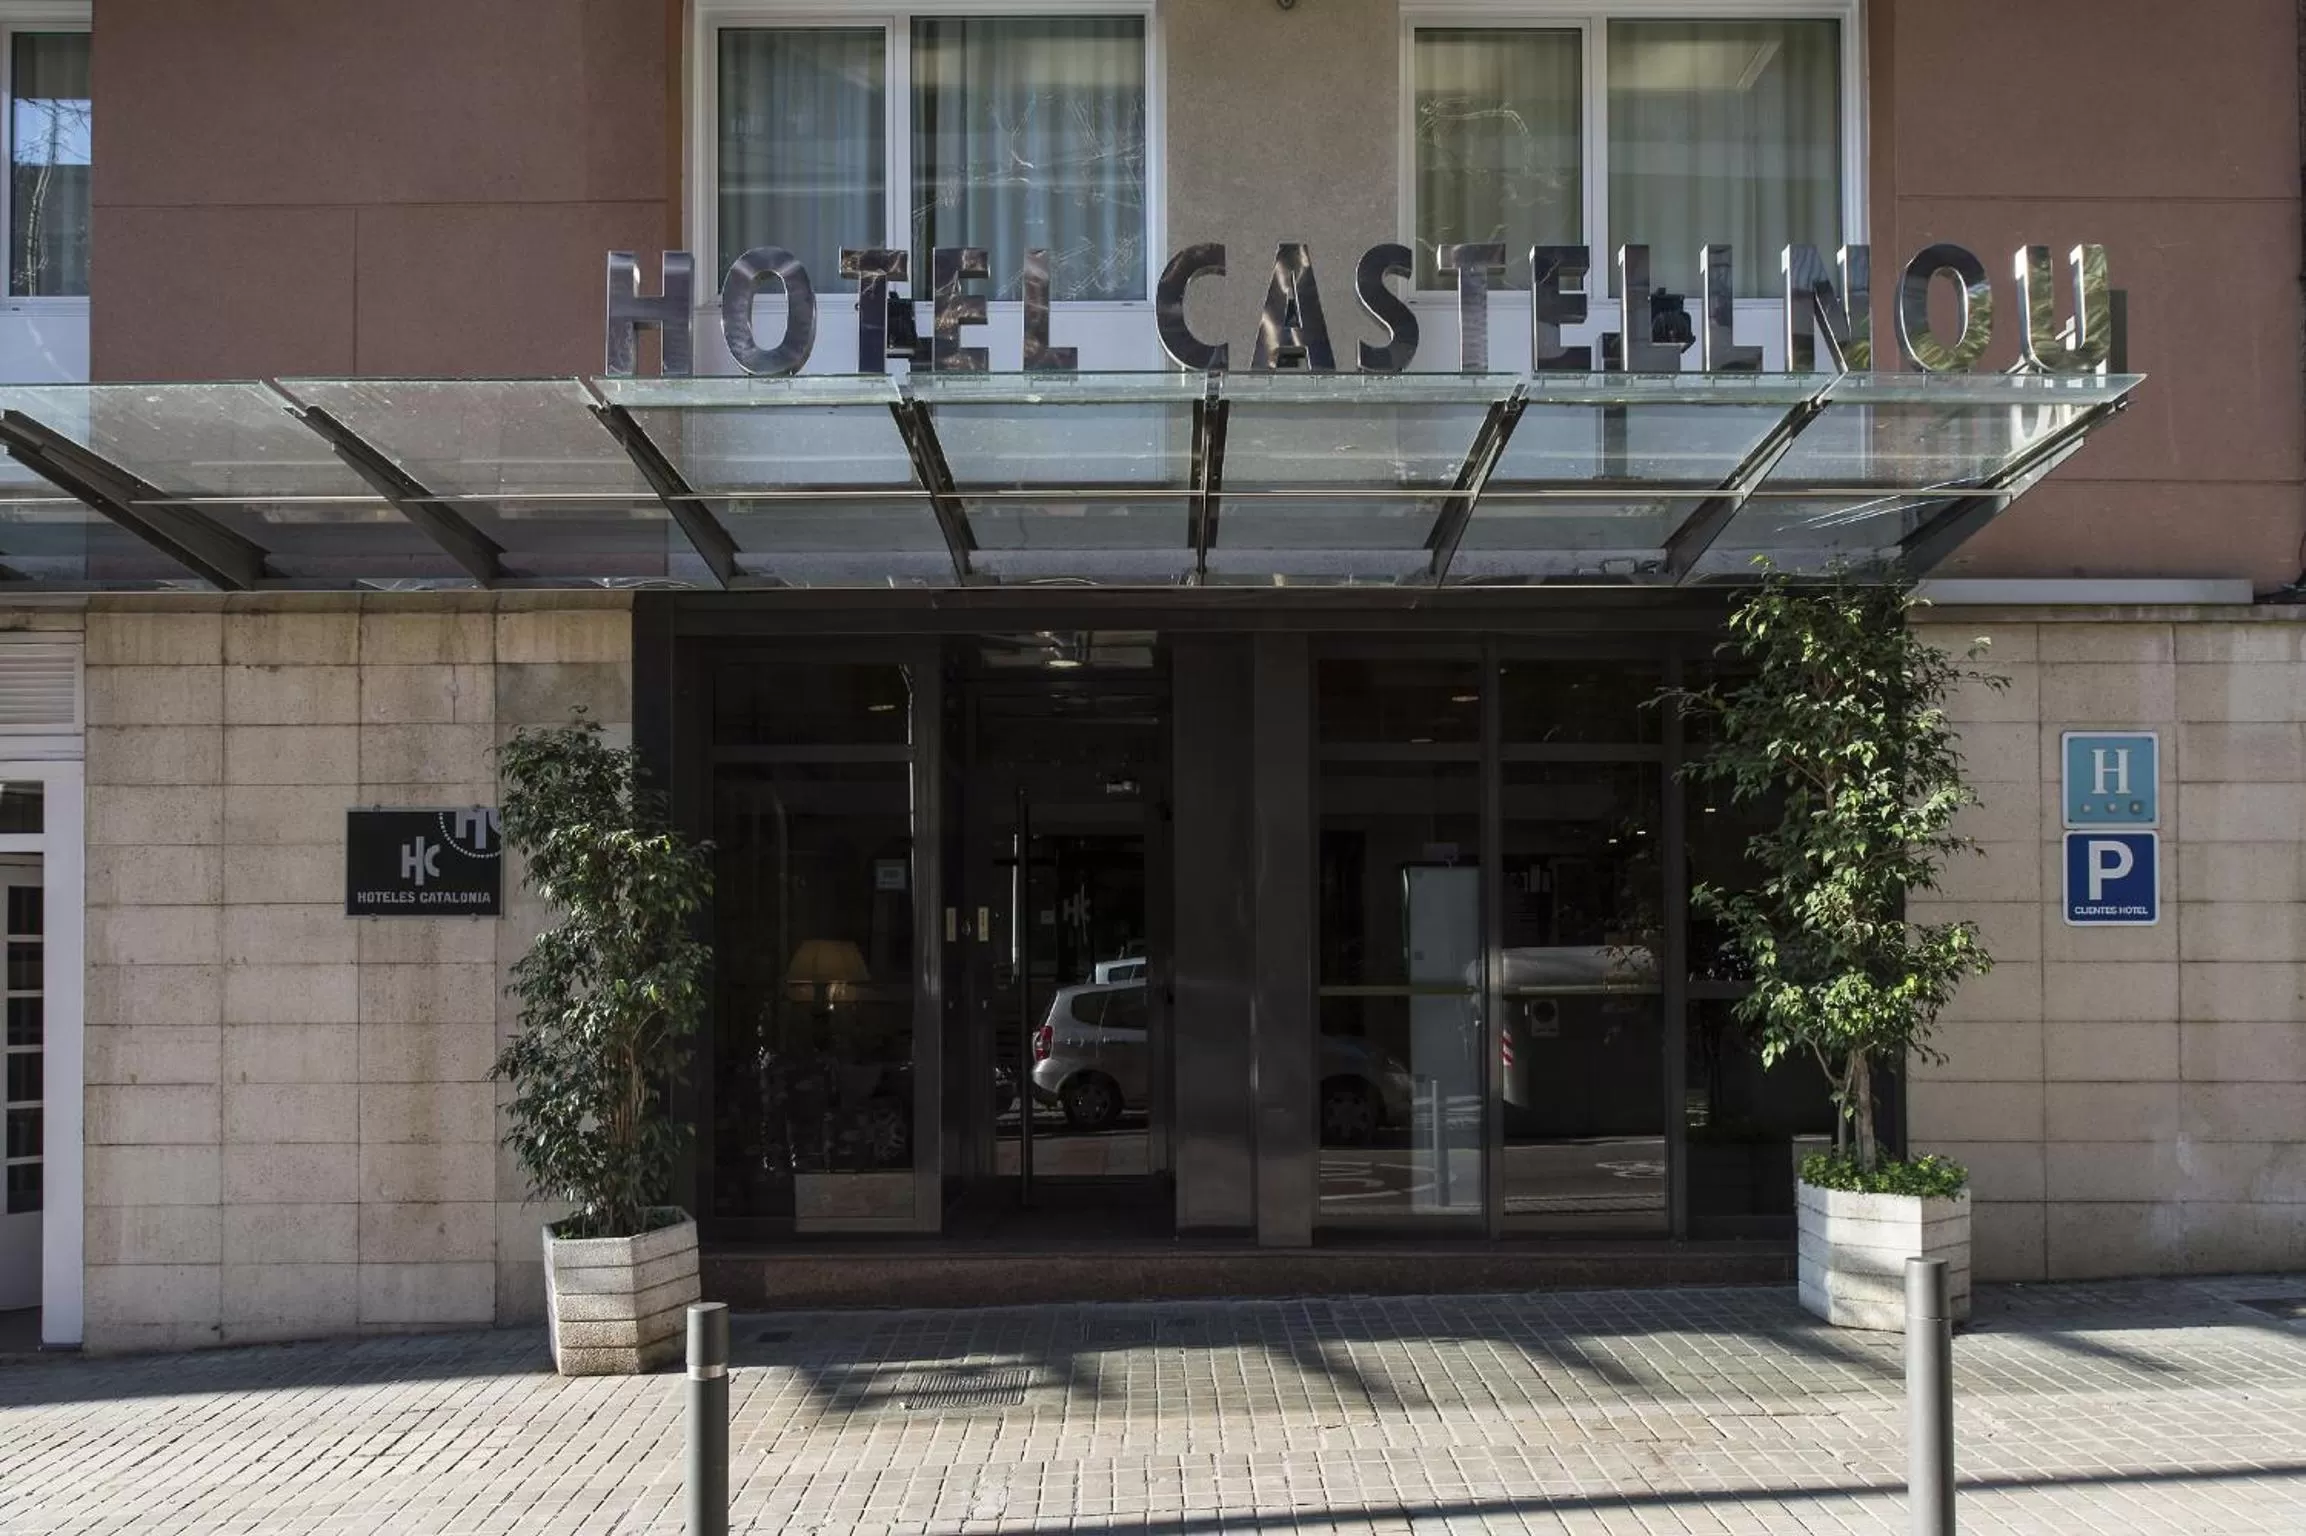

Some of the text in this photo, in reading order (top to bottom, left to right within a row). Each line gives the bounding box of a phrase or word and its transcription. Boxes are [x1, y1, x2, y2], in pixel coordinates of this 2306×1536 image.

[606, 243, 2111, 376] HOTEL CASTELLNOU
[2092, 749, 2132, 794] H
[401, 836, 440, 886] HC
[2088, 840, 2134, 900] P
[357, 891, 491, 904] HOTELES CATALONIA
[2074, 906, 2149, 915] CLIENTES HOTEL
